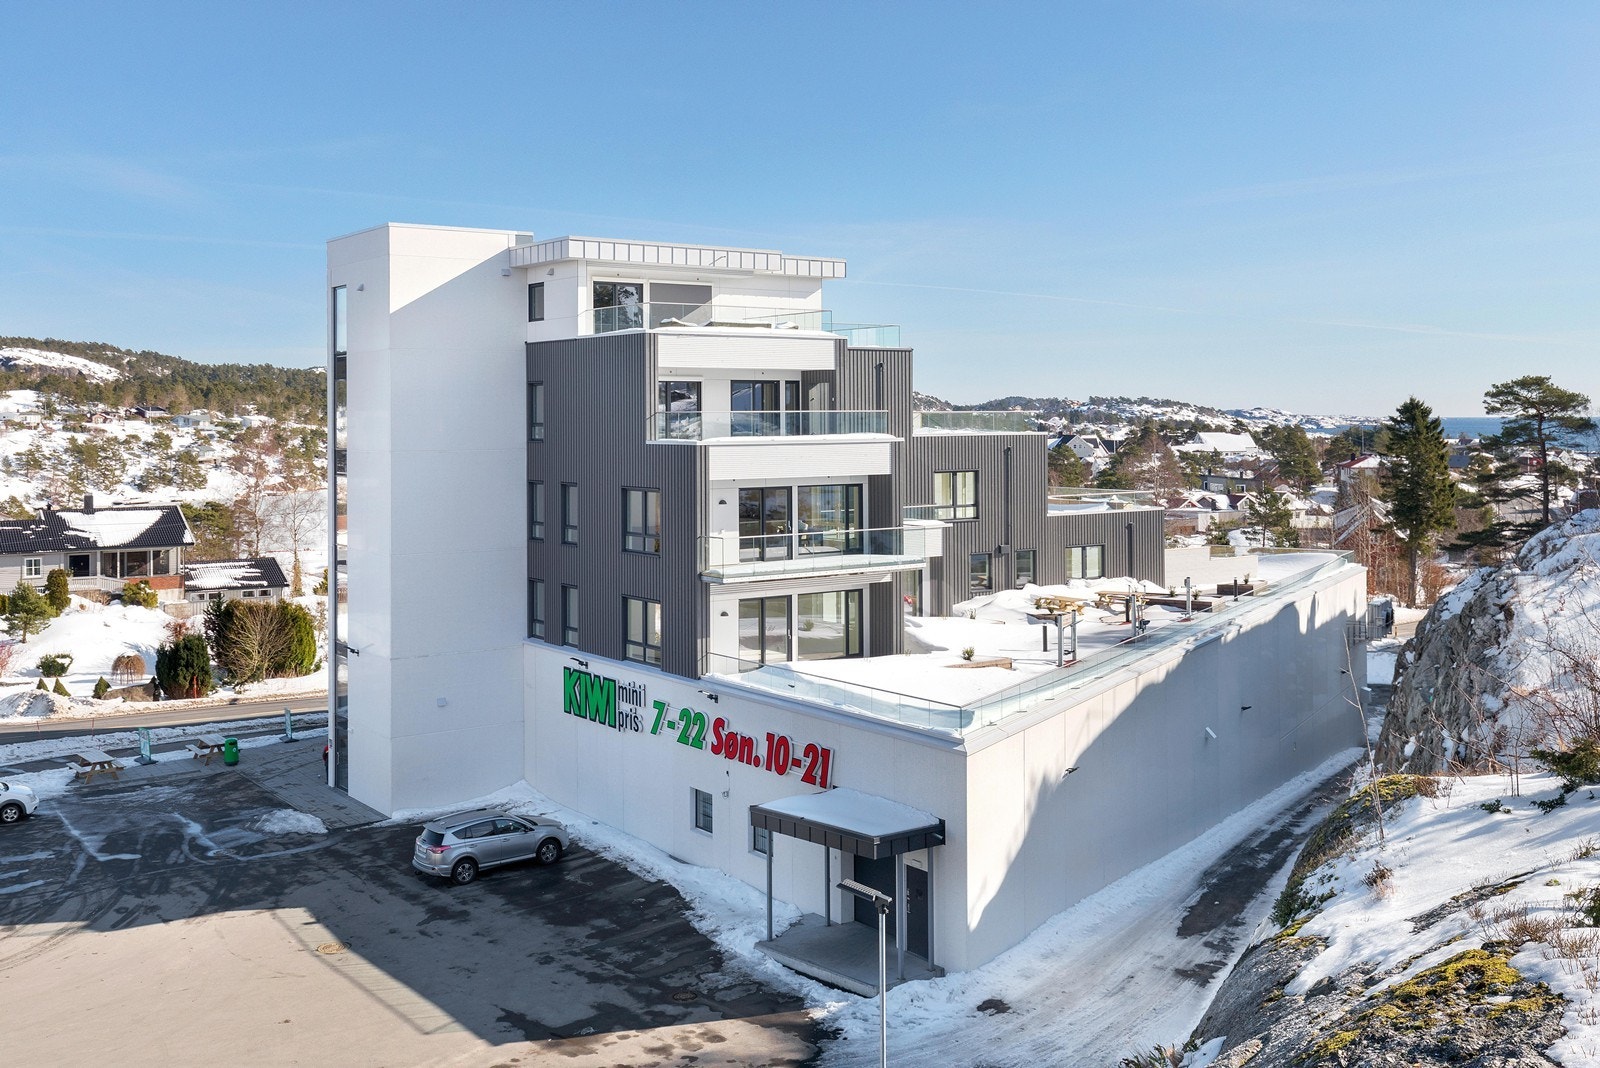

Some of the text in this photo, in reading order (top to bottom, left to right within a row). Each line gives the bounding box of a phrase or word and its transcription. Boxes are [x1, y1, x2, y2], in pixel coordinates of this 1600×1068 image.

[564, 666, 617, 729] KIWI
[618, 683, 642, 708] mini
[618, 708, 640, 733] pris
[650, 699, 831, 789] 7-22 Søn. 10-21
